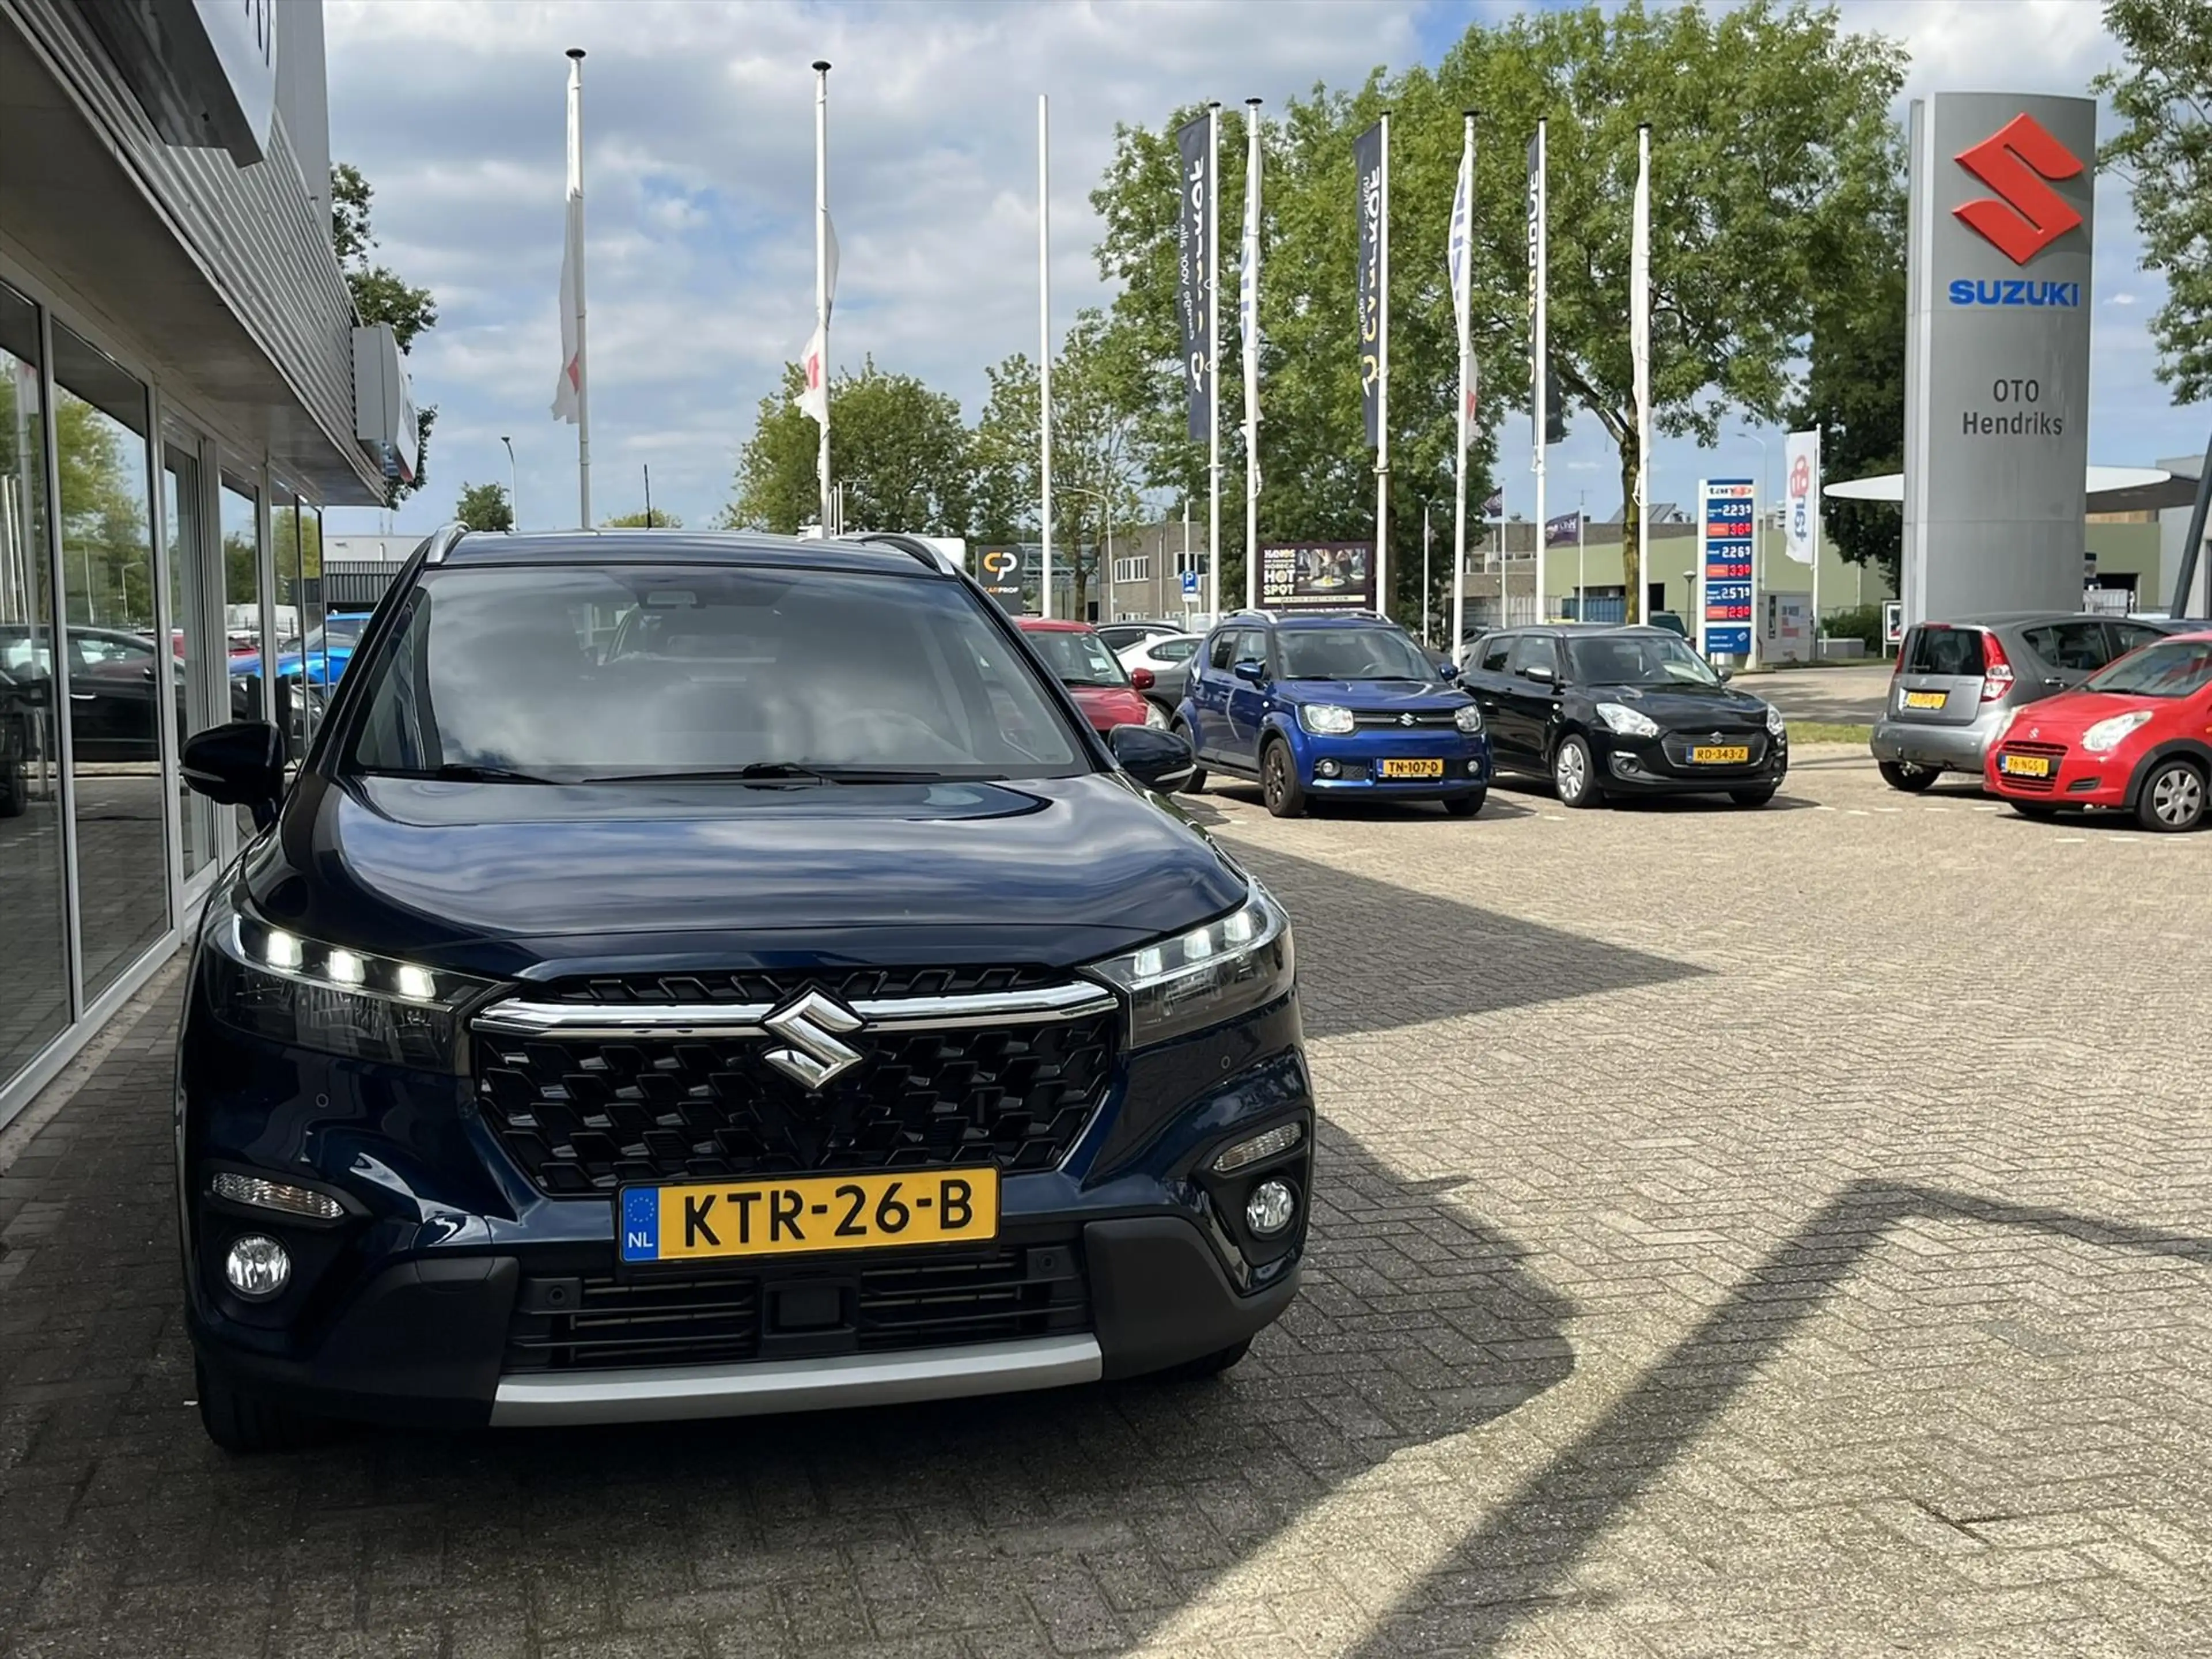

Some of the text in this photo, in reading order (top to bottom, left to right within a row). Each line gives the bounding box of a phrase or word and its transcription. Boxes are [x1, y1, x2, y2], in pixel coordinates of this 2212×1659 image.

[1949, 279, 2078, 307] SUZUKI
[1993, 378, 2039, 403] OTO
[1963, 411, 2063, 435] Hendriks
[1185, 573, 1194, 585] P
[1263, 570, 1296, 584] HOT
[1263, 584, 1295, 596] SPOT
[1388, 761, 1438, 772] TN-107-D
[684, 1179, 974, 1248] KTR-26-B
[628, 1231, 654, 1248] NL
